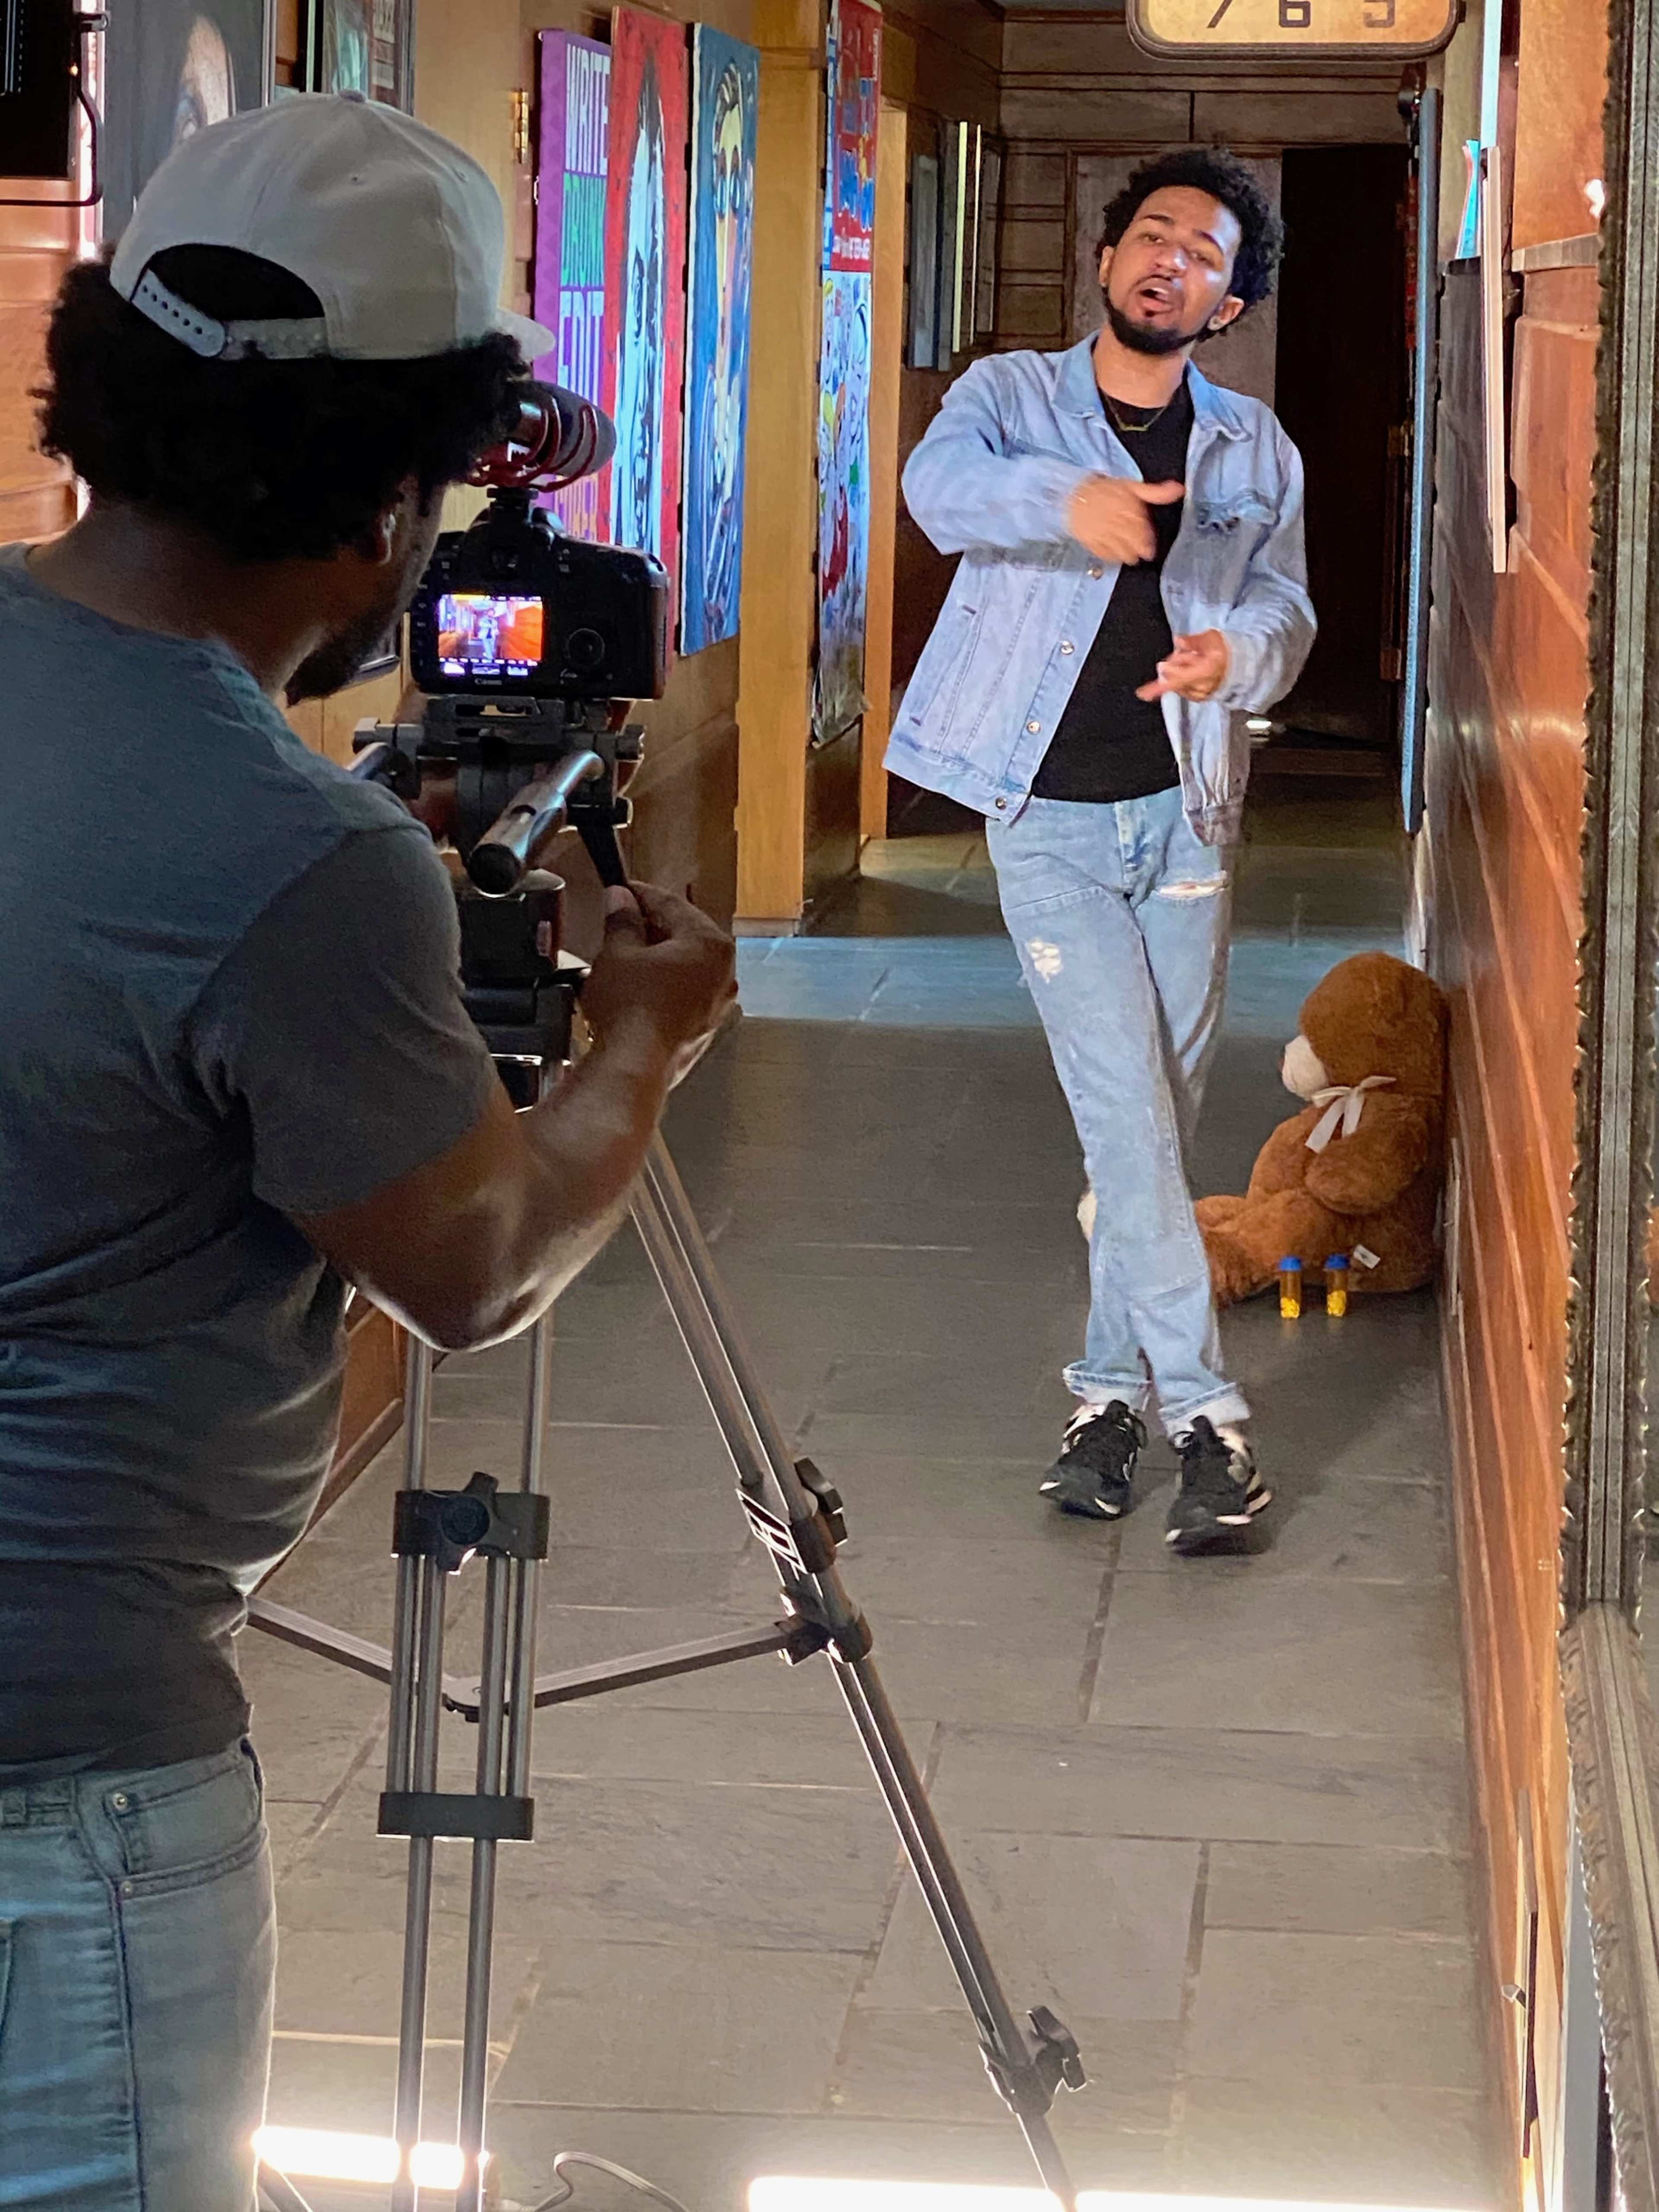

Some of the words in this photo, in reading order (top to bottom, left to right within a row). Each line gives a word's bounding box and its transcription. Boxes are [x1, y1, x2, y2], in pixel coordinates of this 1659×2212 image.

[566, 43, 610, 175] WRITE
[560, 172, 607, 287] DRUNK
[559, 291, 604, 406] EDIT
